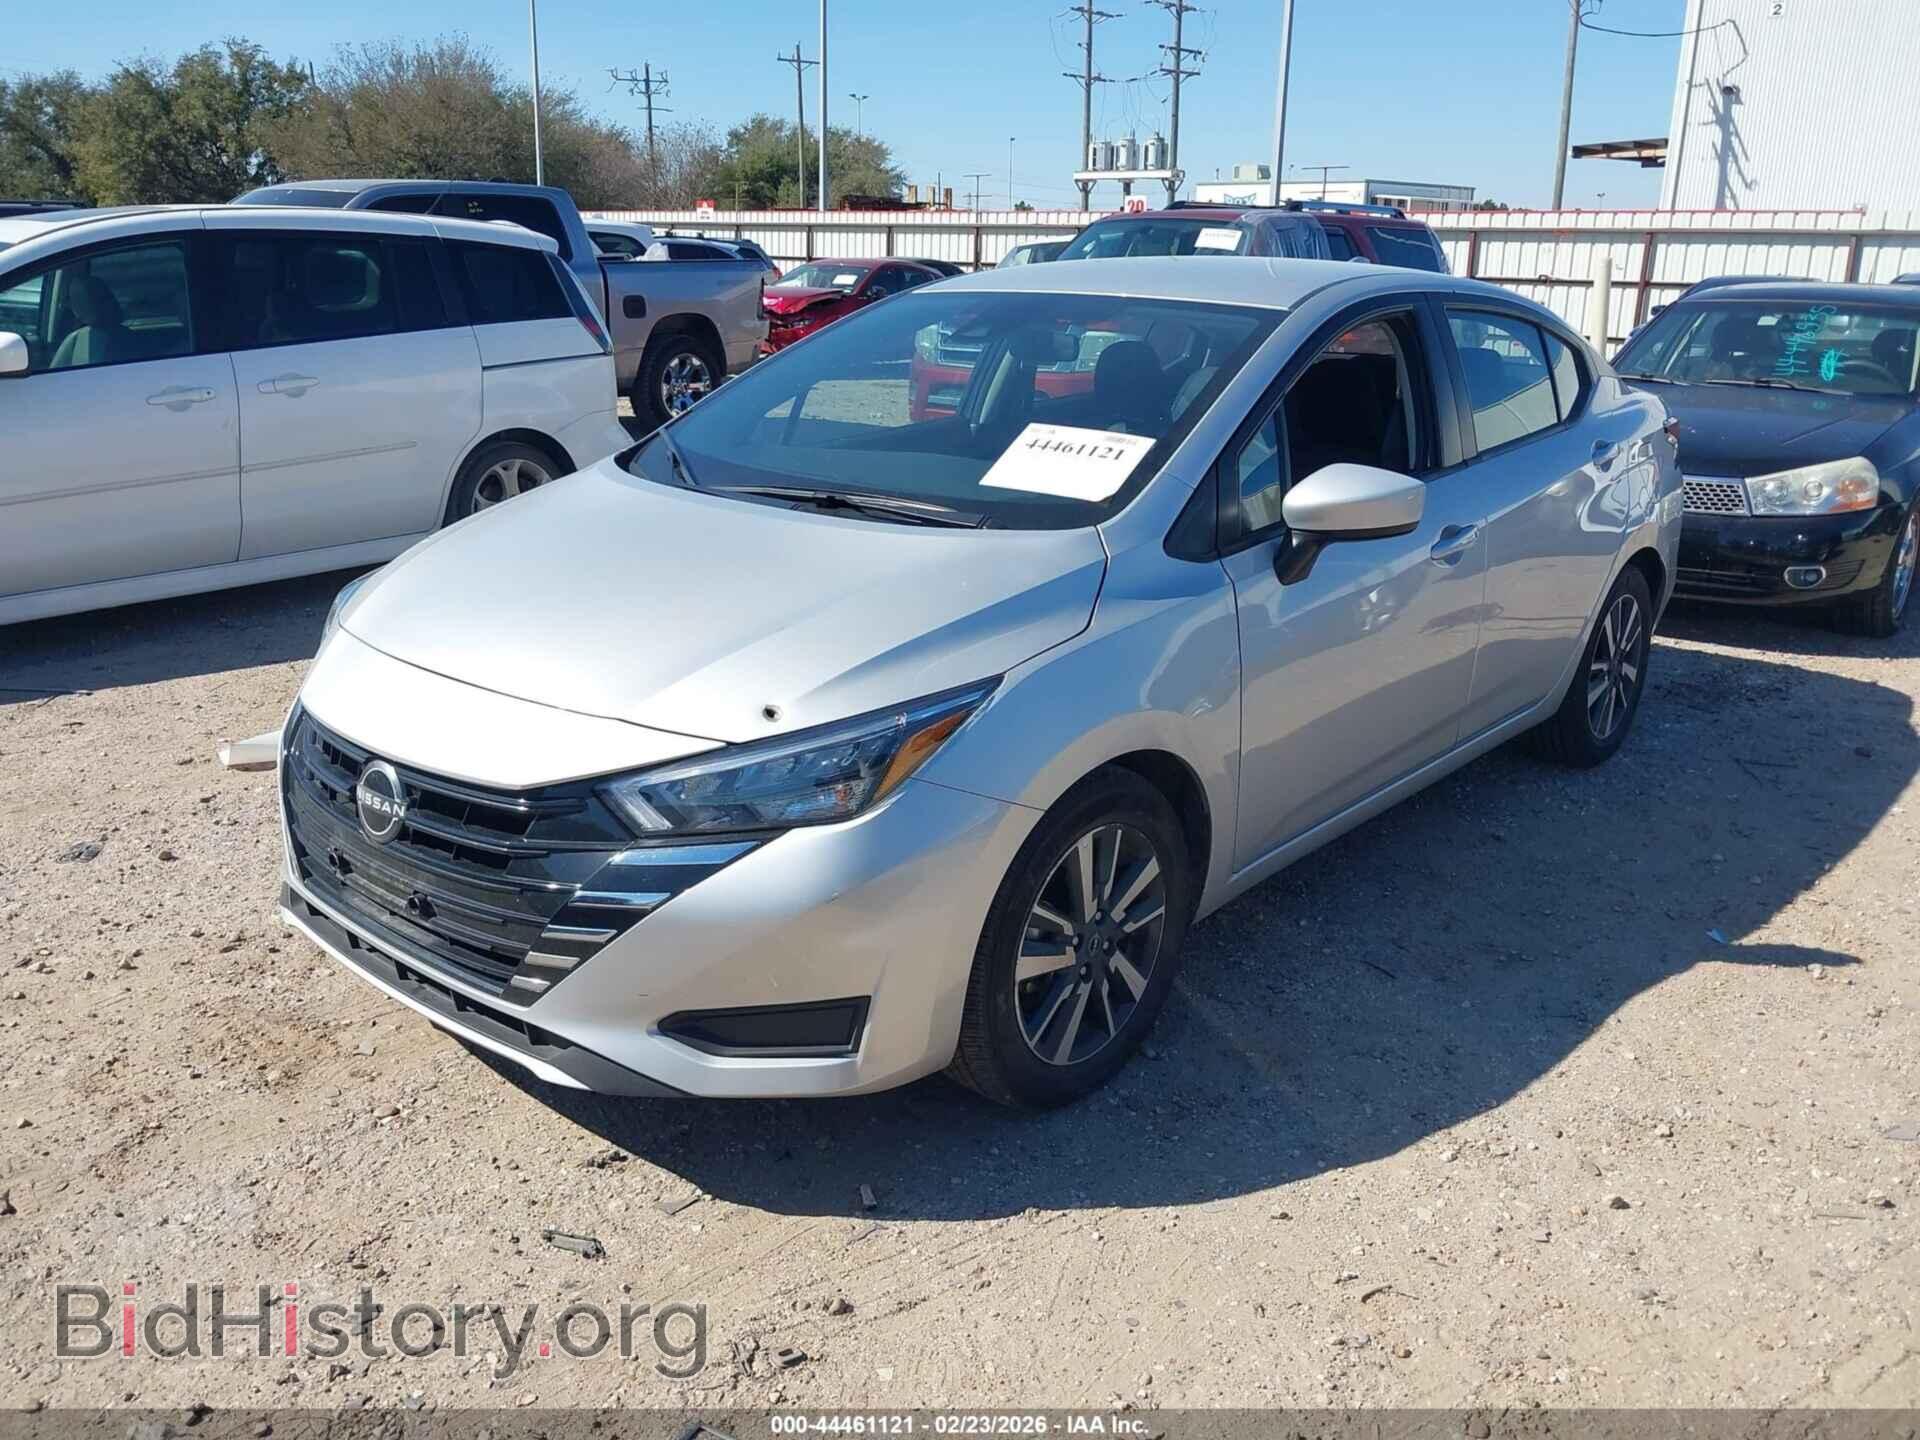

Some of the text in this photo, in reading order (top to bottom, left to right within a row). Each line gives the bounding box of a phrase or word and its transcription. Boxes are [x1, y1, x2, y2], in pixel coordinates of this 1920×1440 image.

[1772, 3, 1783, 16] 2
[1127, 199, 1145, 215] 20
[1025, 438, 1125, 461] 44461121
[356, 784, 406, 817] NISSAN
